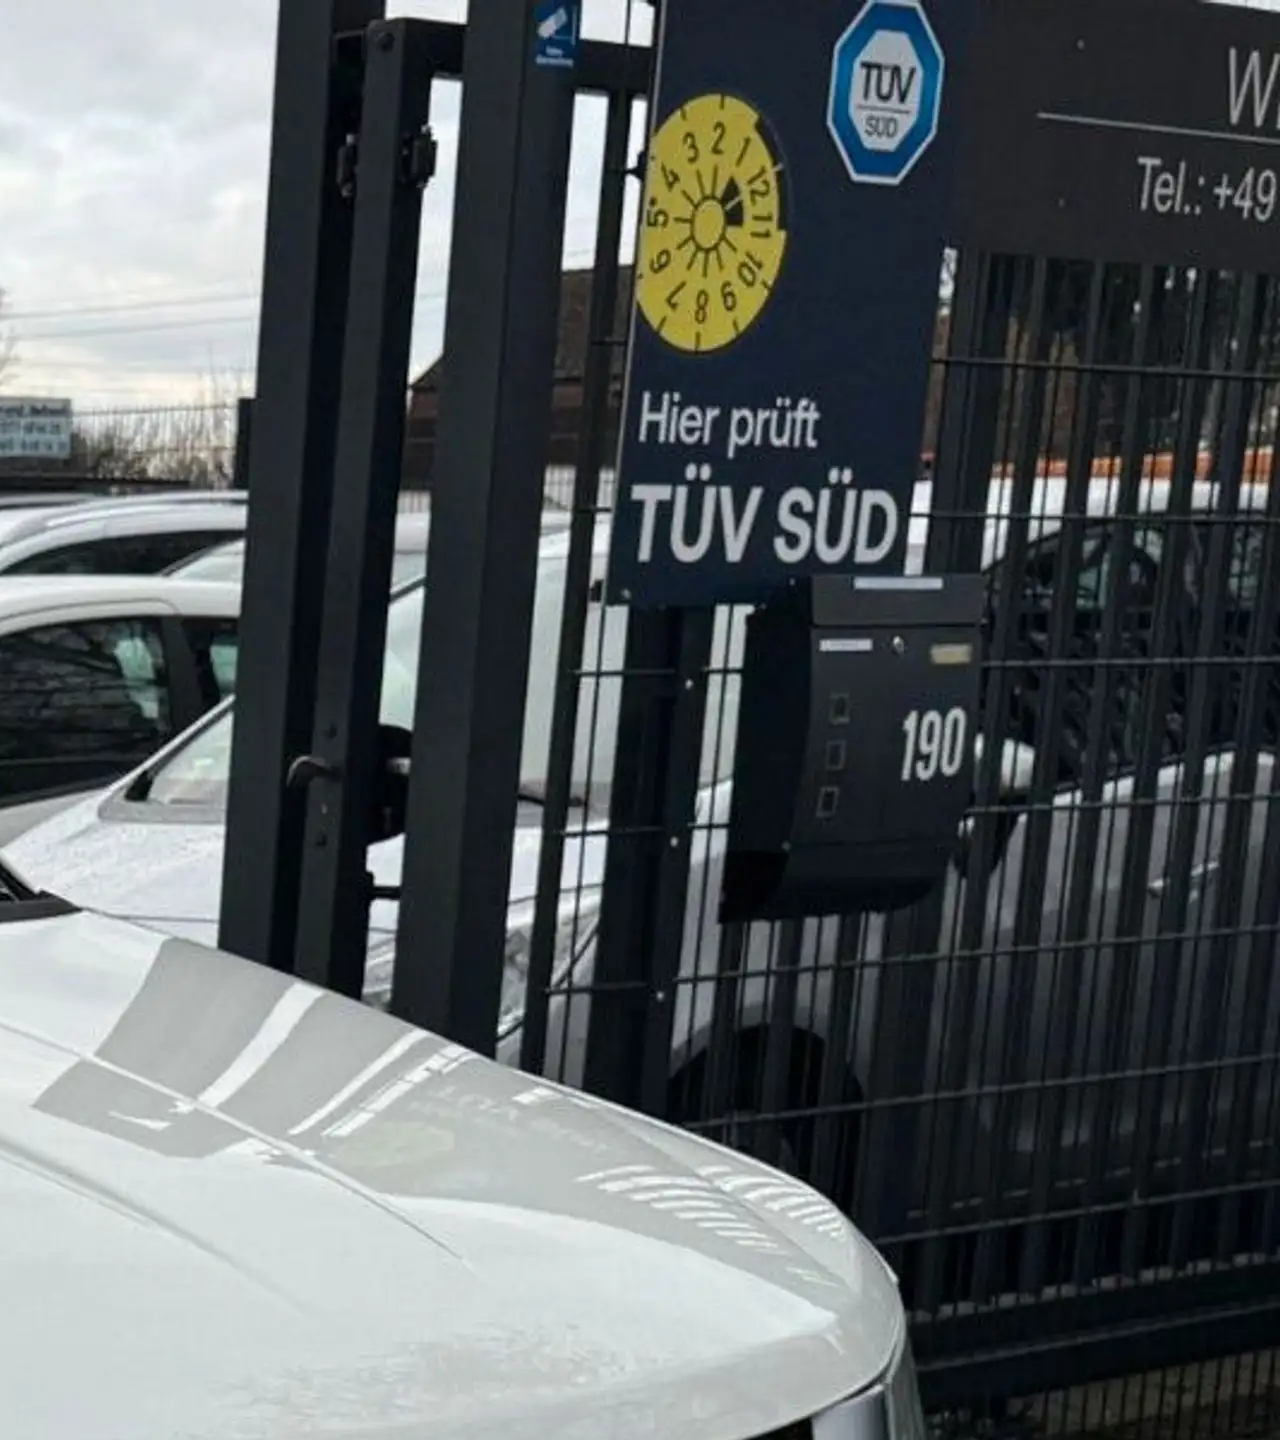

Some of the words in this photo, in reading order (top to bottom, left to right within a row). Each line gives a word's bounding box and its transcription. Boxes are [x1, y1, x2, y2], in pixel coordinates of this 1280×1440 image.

[860, 61, 917, 103] TÜV
[1228, 47, 1280, 131] W
[711, 121, 726, 155] 2
[864, 114, 899, 138] SÜD
[682, 131, 699, 164] 3
[735, 136, 751, 168] 1
[660, 163, 681, 192] 4
[746, 165, 771, 207] 12
[1137, 155, 1206, 216] Tel.:
[1213, 166, 1277, 222] +49
[646, 208, 669, 228] 5
[750, 211, 773, 240] 11
[648, 249, 672, 275] 6
[736, 252, 763, 289] 10
[665, 280, 687, 312] 7
[694, 289, 709, 325] 8
[720, 280, 737, 312] 9
[639, 390, 721, 445] Hier
[727, 396, 820, 460] prüft
[631, 463, 764, 563] TÜV
[773, 467, 898, 564] SÜD
[901, 706, 967, 782] 190
